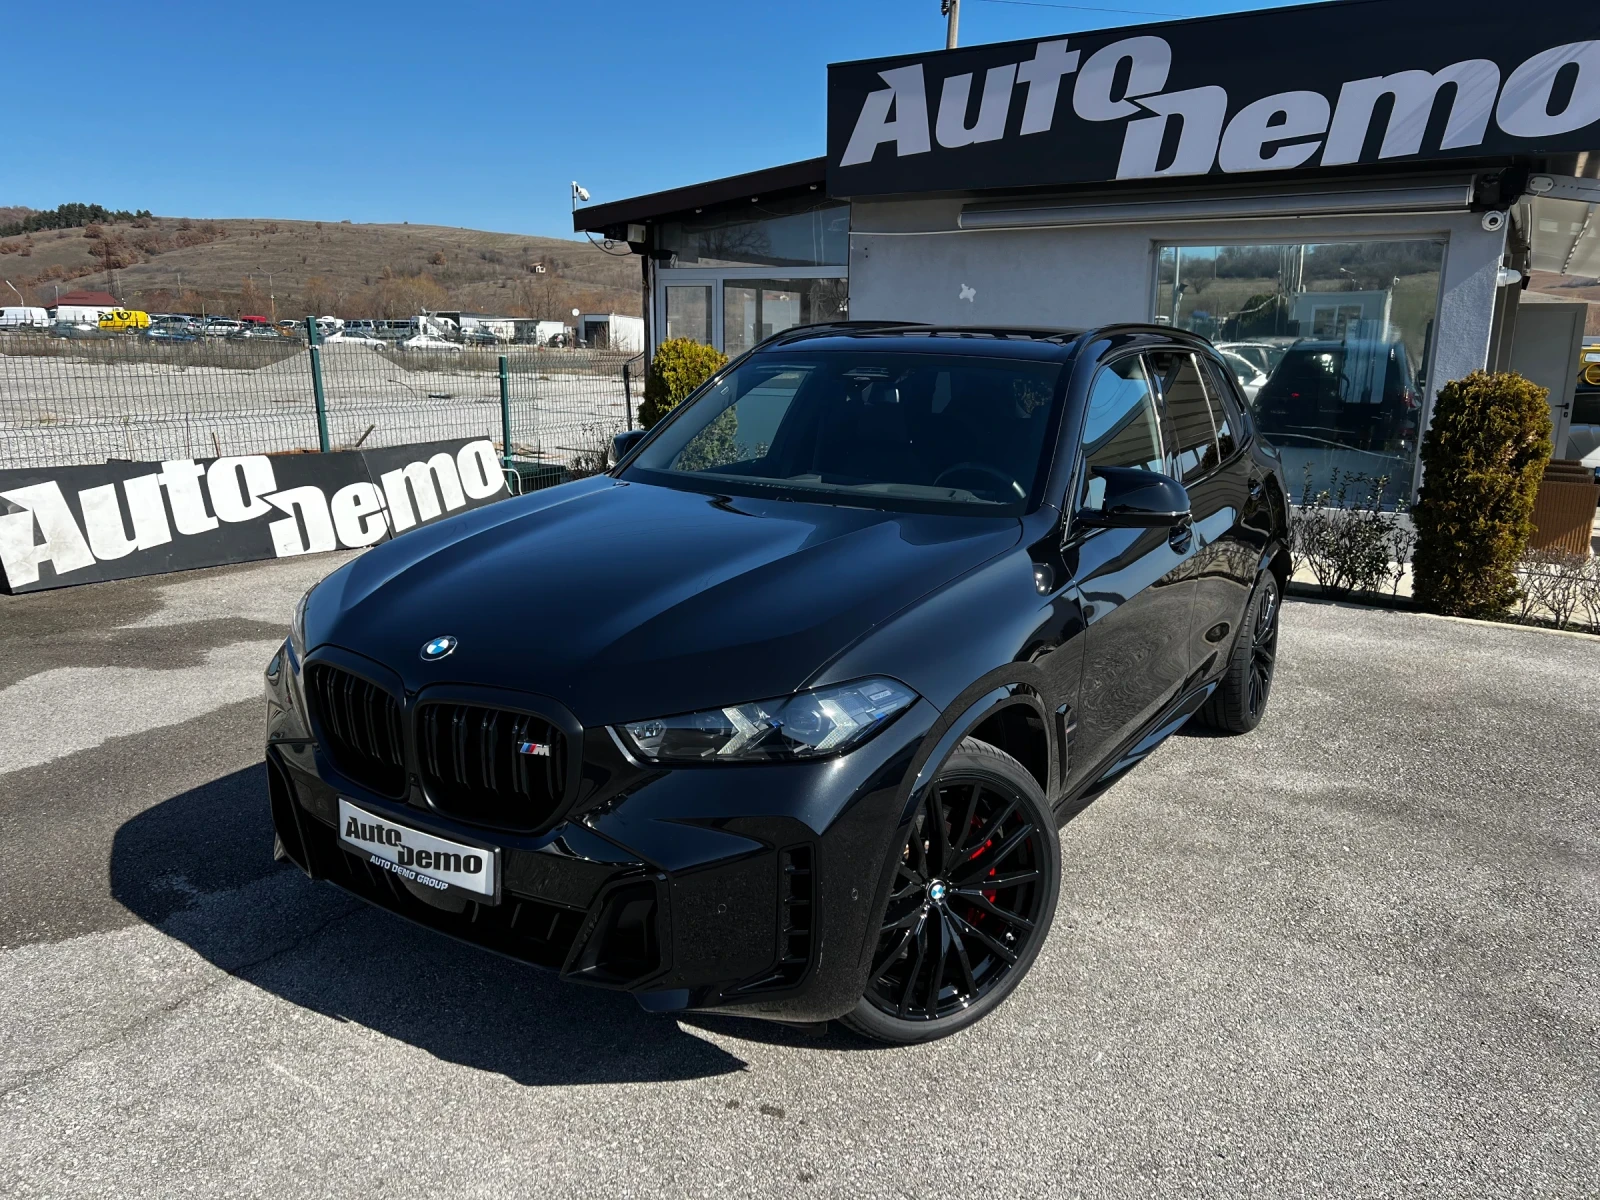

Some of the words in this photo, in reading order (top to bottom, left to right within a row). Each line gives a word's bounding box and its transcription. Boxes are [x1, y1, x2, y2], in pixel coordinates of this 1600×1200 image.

[840, 36, 1171, 167] Auto
[1116, 40, 1600, 180] Demo
[0, 455, 277, 588] Auto
[266, 440, 505, 557] Demo
[345, 816, 402, 846] Auto
[370, 855, 391, 869] AUTO
[391, 865, 416, 880] DEMO
[417, 874, 449, 891] GROUP
[397, 843, 483, 874] Demo
